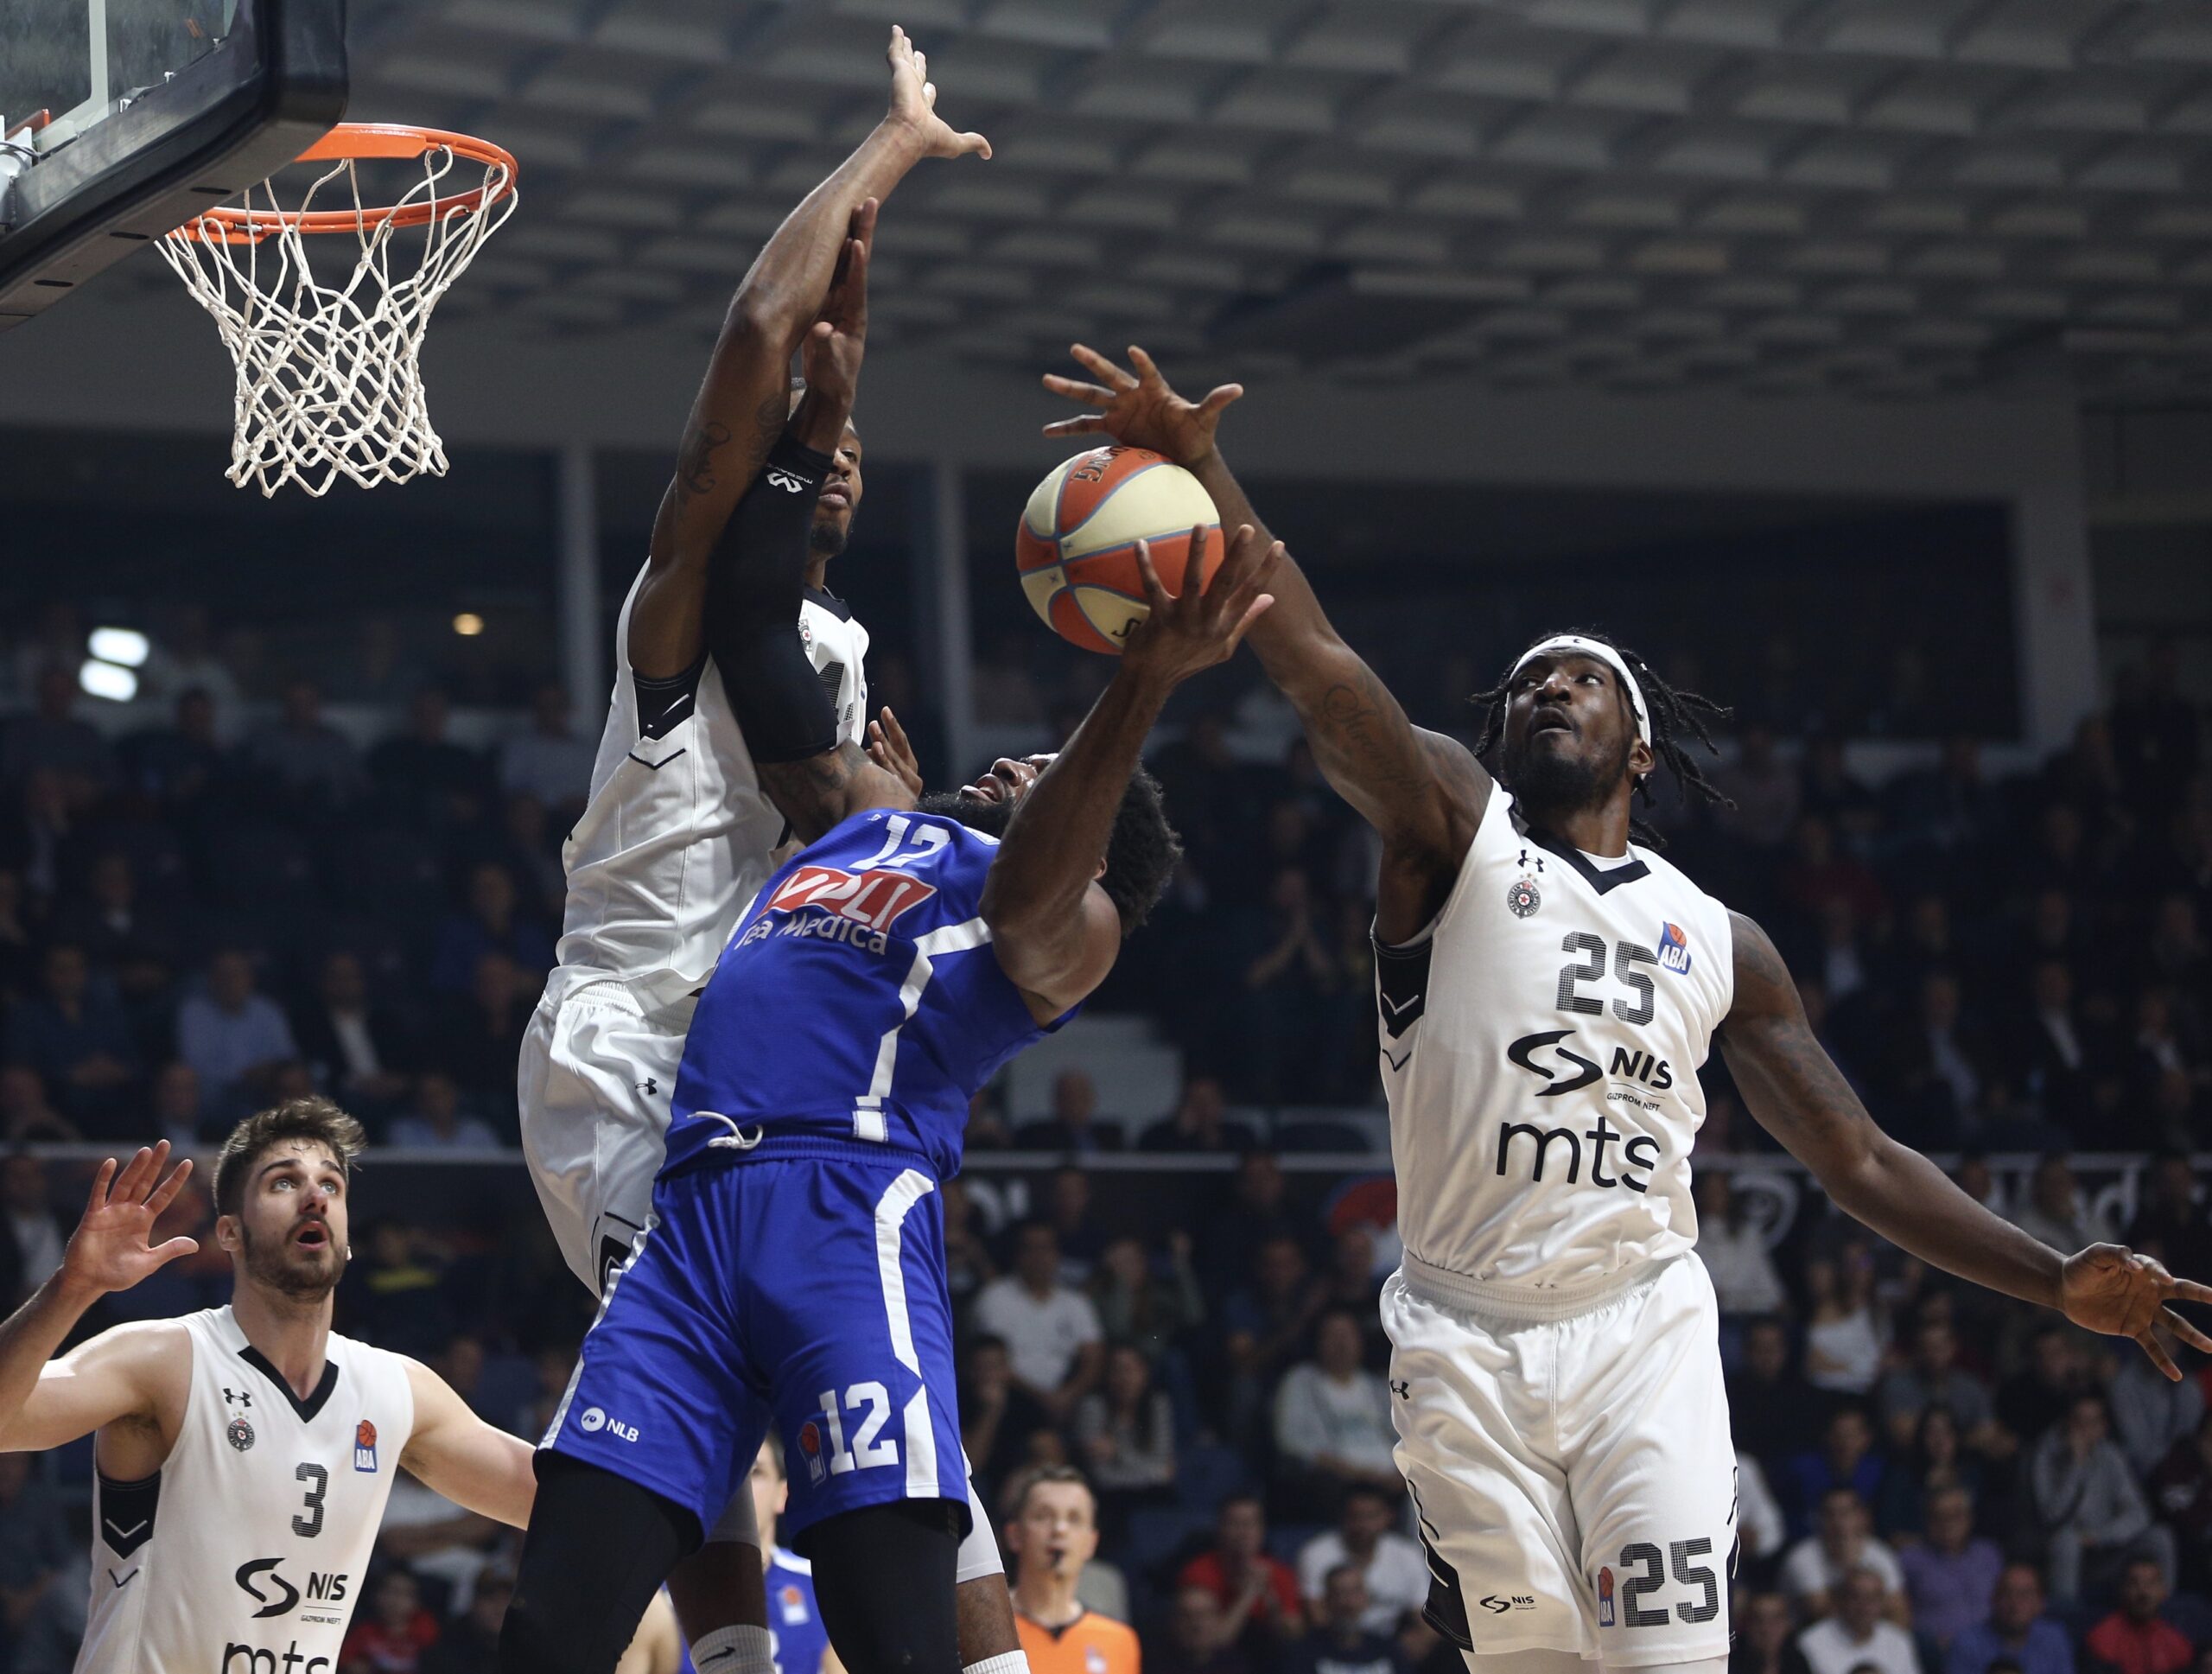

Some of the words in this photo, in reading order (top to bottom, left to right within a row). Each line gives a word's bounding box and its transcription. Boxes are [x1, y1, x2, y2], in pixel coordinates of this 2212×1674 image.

[848, 814, 951, 870] 12
[776, 913, 887, 955] Medica
[1555, 931, 1660, 1027] 25
[1660, 945, 1688, 971] ABA
[1609, 1047, 1673, 1090] NIS
[1496, 1116, 1661, 1194] mts
[606, 1417, 639, 1443] NLB
[818, 1381, 899, 1475] 12
[355, 1448, 376, 1469] ABA
[291, 1461, 328, 1538] 3
[307, 1571, 348, 1601] NIS
[1511, 1595, 1535, 1605] NIS
[1619, 1537, 1719, 1628] 25
